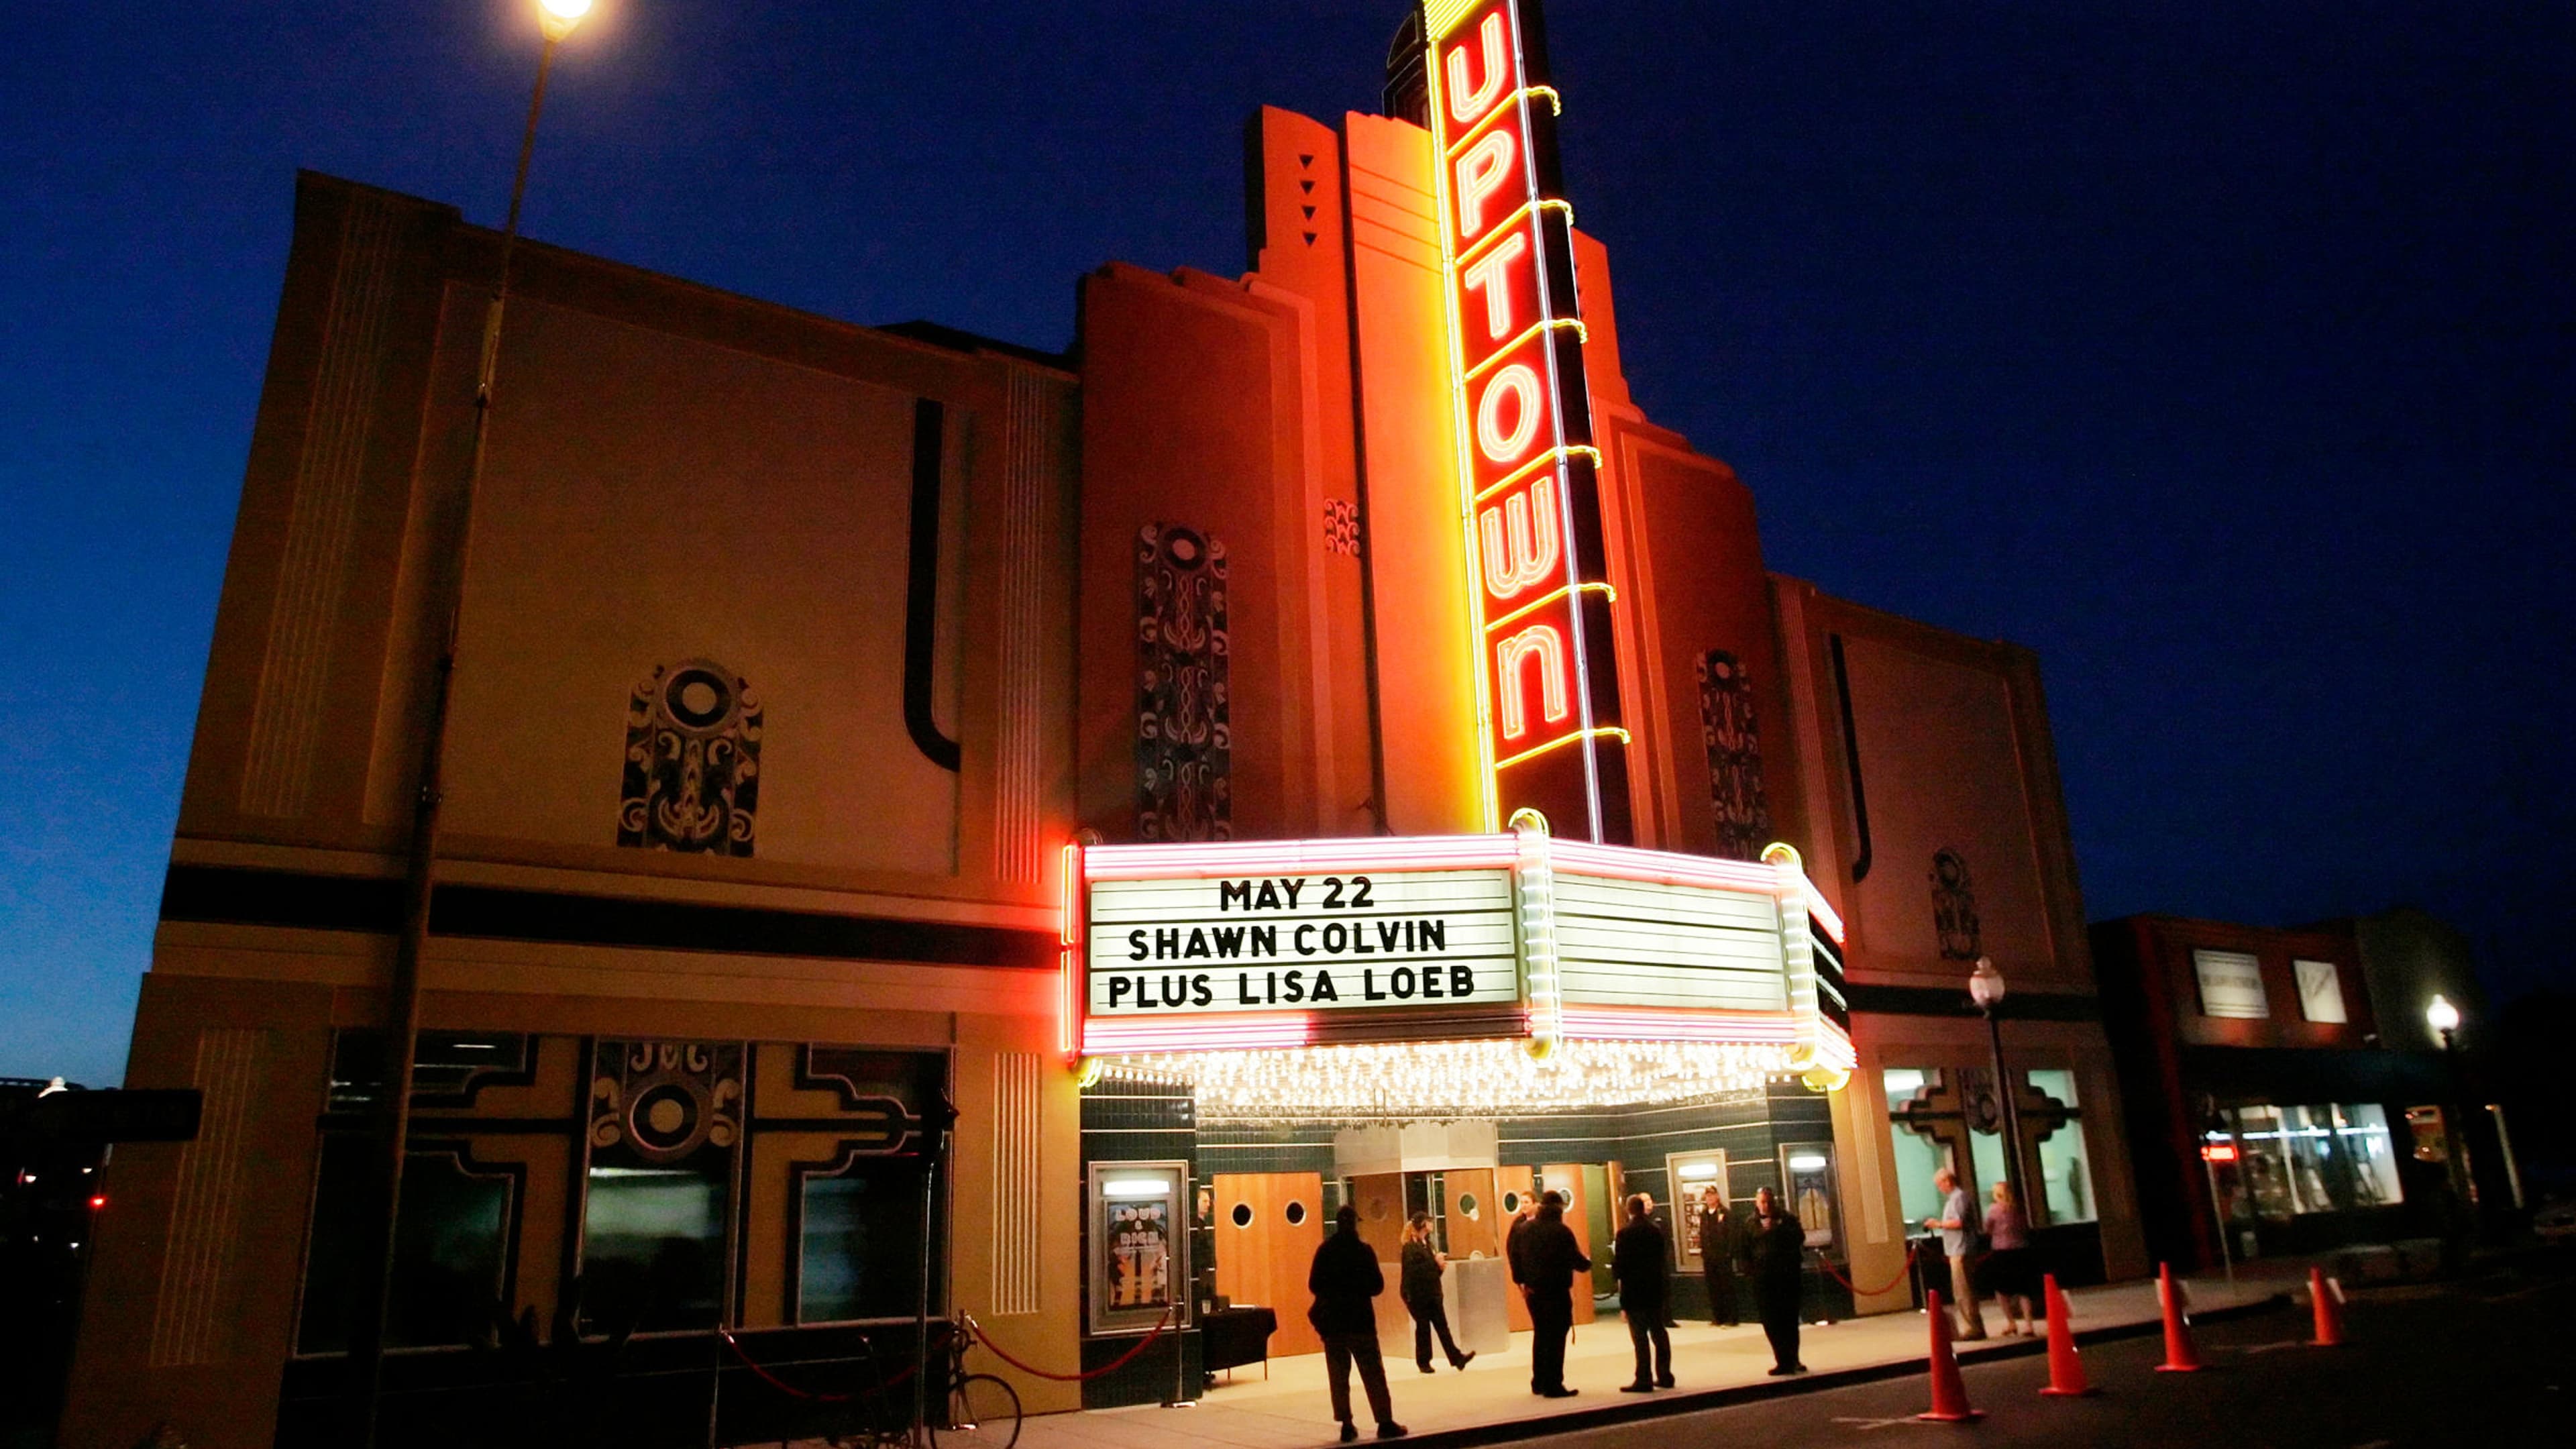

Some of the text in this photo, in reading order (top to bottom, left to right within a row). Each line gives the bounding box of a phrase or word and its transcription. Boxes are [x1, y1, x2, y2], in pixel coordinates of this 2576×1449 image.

[1220, 876, 1375, 912] MAY 22
[1128, 920, 1446, 961] SHAWN COLVIN
[1109, 965, 1475, 1008] PLUS LISA LOEB
